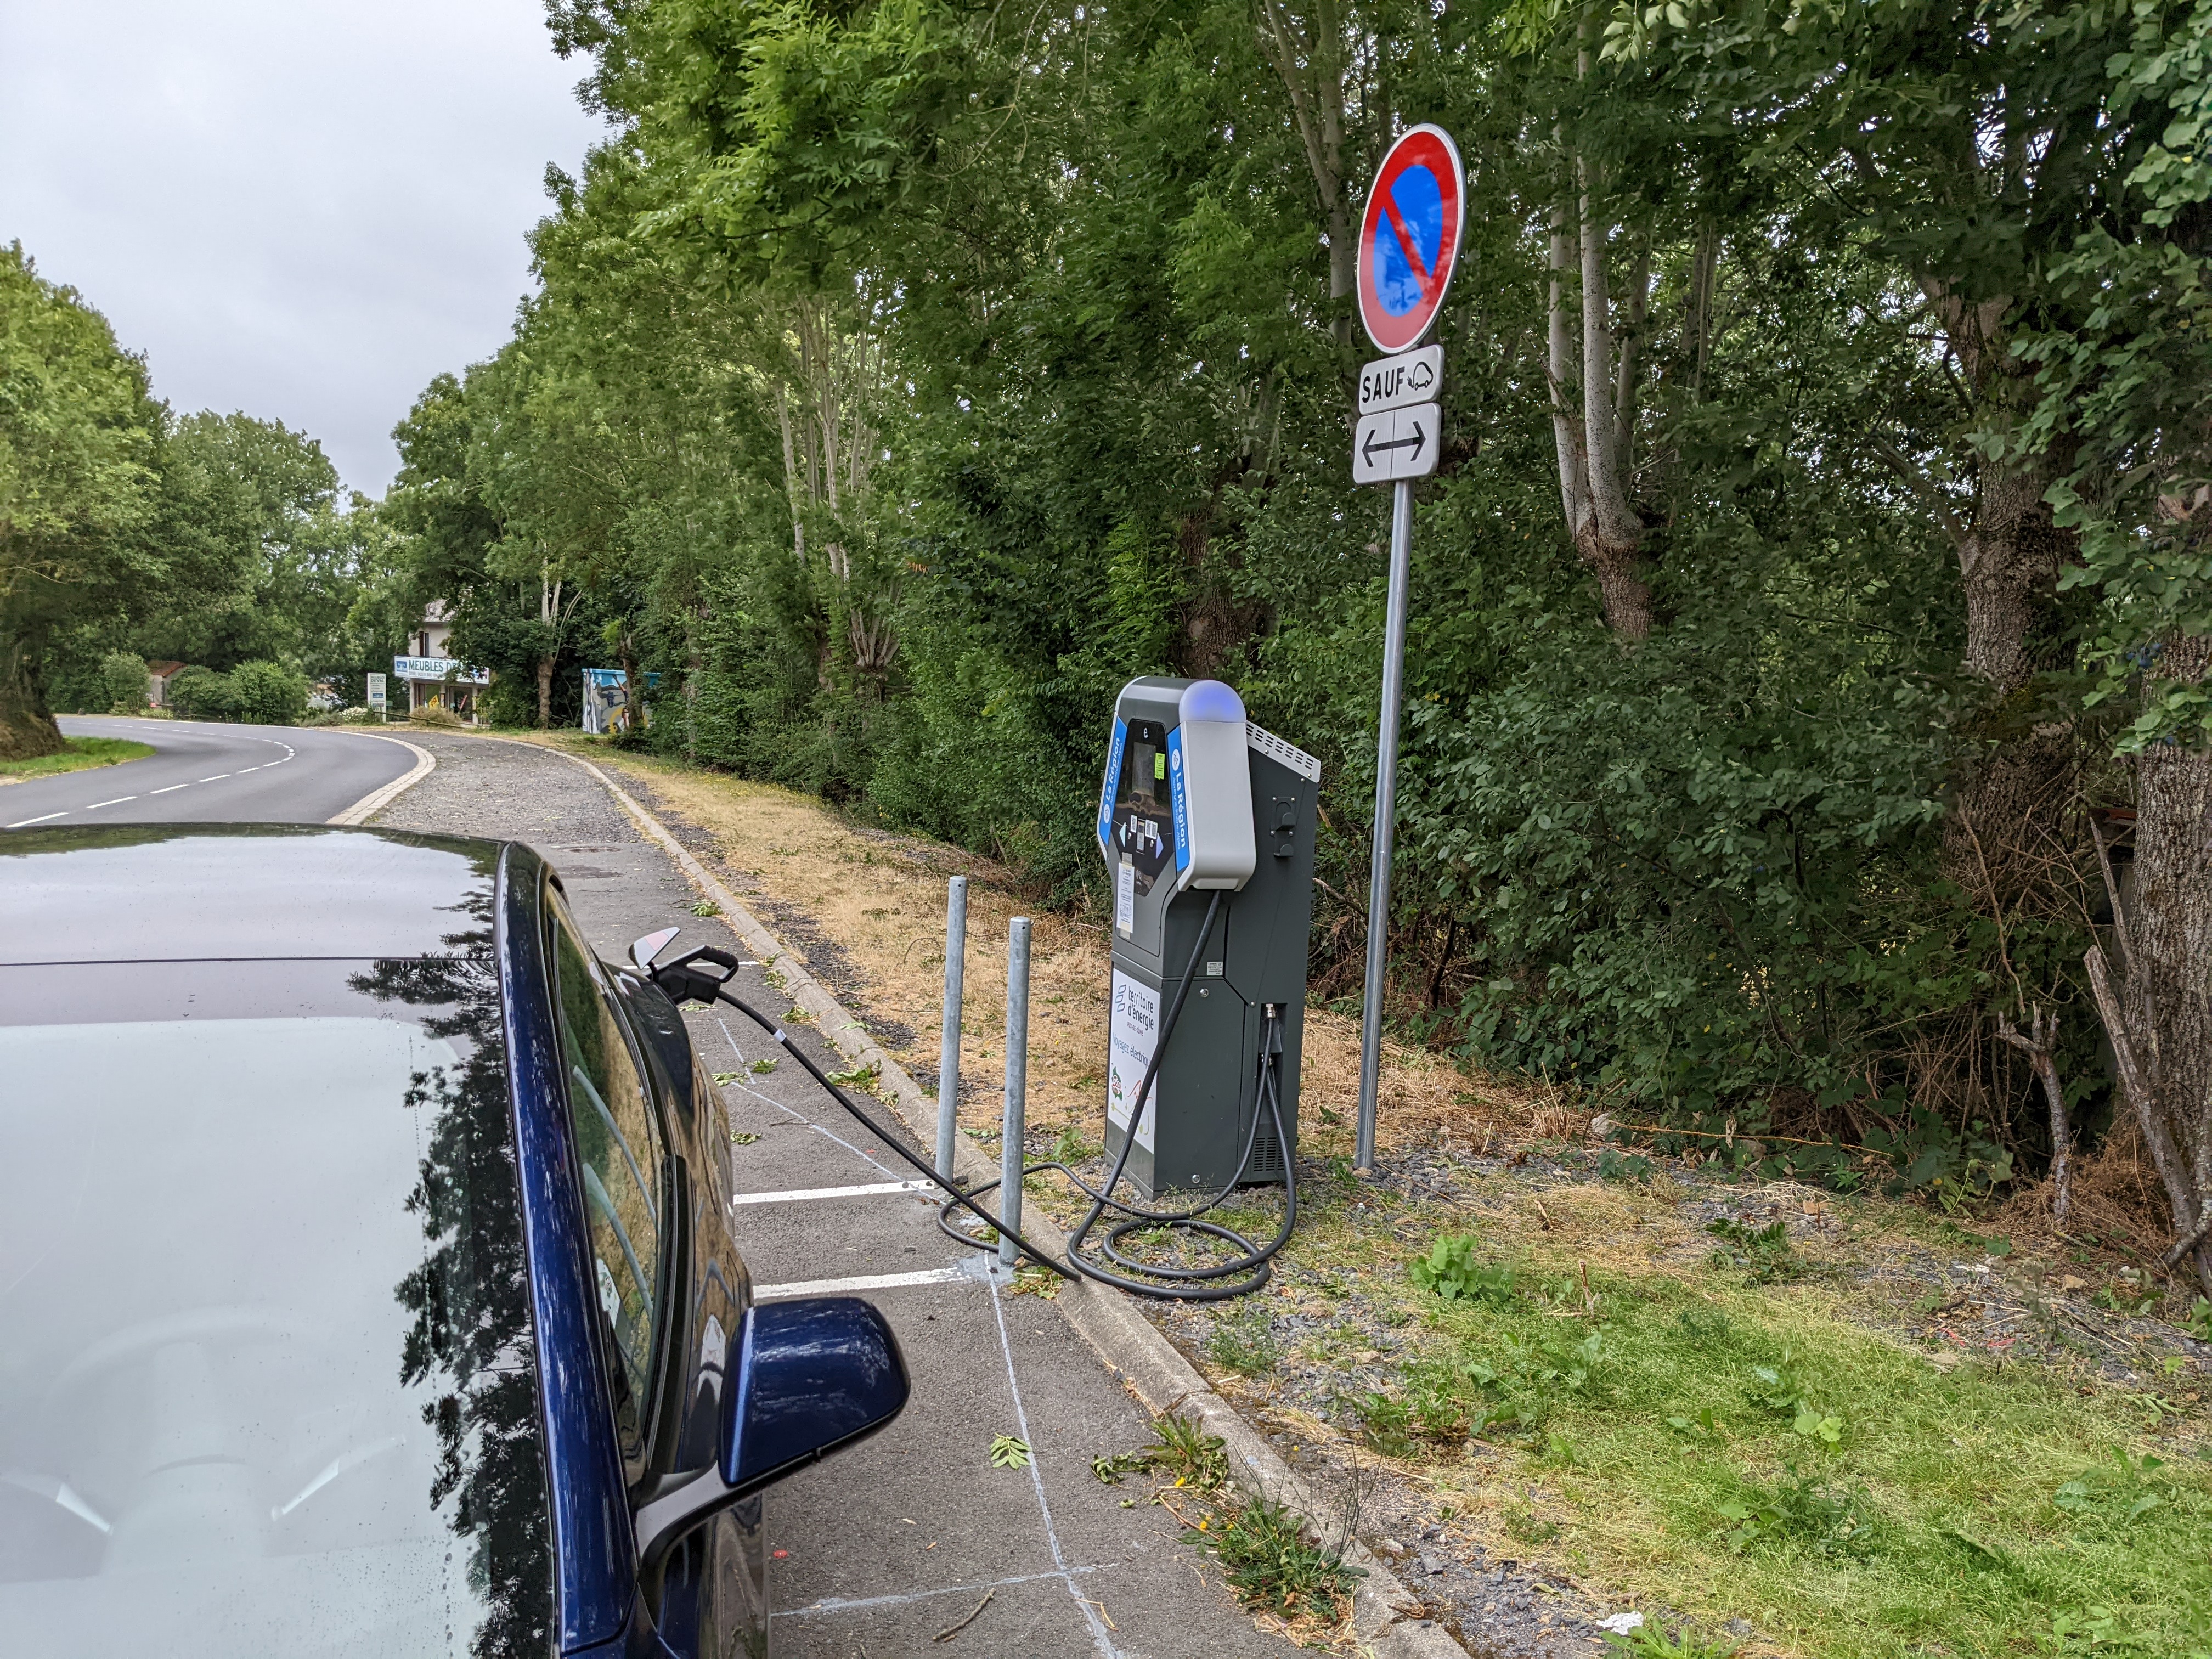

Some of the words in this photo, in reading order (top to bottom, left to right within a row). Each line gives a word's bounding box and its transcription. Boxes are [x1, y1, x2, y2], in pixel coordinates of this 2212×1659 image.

[1362, 366, 1406, 403] SAUF
[409, 659, 444, 672] MEUBLES
[1108, 737, 1120, 784] Région
[1105, 786, 1112, 802] La
[1176, 772, 1182, 791] La
[1177, 793, 1186, 848] Région
[1128, 986, 1154, 1014] territoire
[1127, 1002, 1154, 1031] d'énergie
[1127, 1021, 1143, 1036] PUY-DE-DÔME
[1113, 1032, 1130, 1054] Voyagez
[1130, 1043, 1150, 1070] électriqu
